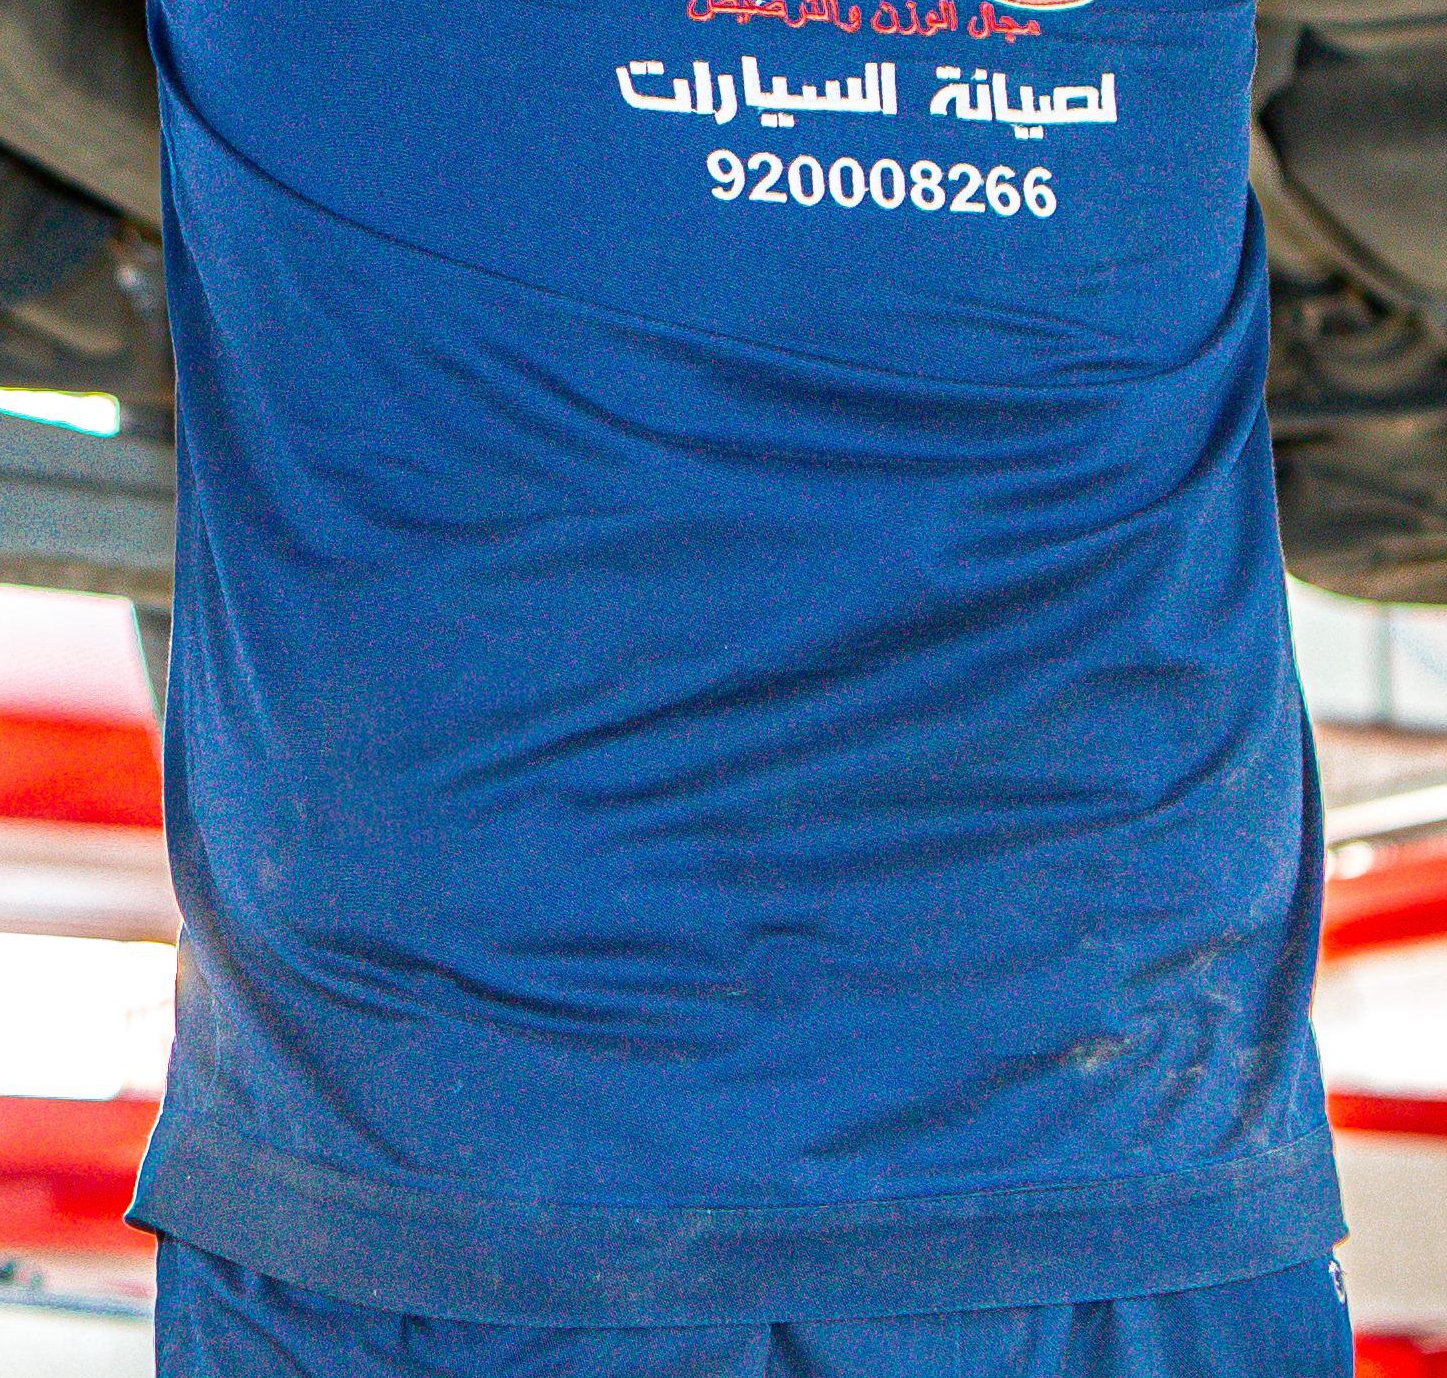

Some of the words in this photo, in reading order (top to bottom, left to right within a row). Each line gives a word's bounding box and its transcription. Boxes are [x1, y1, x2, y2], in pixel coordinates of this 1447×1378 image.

[967, 1, 1042, 42] مجال
[616, 55, 898, 127] السيارات
[930, 65, 1118, 139] لصيانة
[706, 148, 1057, 218] 920008266
